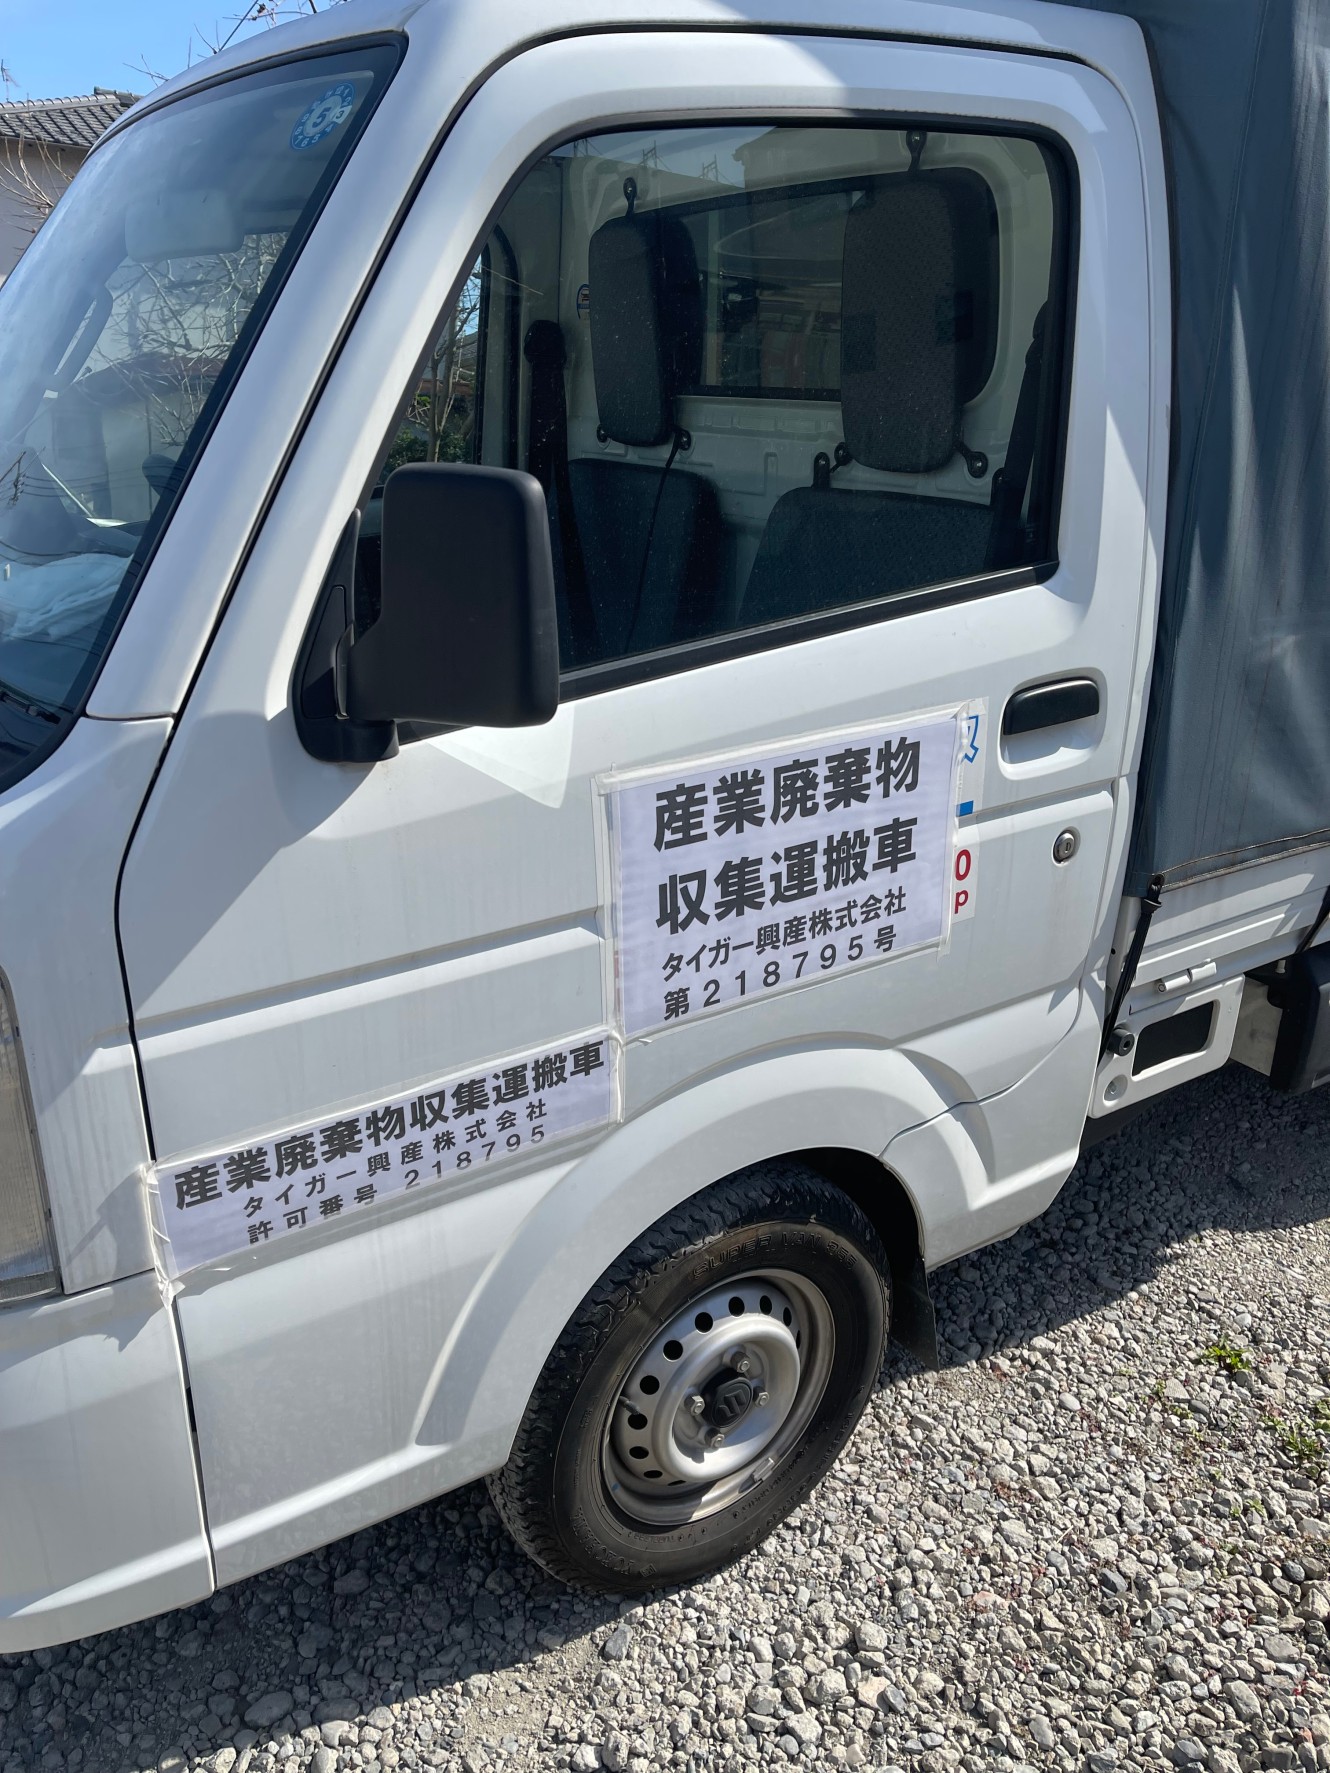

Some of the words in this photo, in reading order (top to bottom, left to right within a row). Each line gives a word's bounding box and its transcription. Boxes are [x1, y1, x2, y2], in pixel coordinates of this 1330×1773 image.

[312, 107, 332, 128] 5
[335, 110, 345, 119] 3
[653, 736, 921, 853] 産業廃棄物
[655, 817, 918, 935] 収集運搬車
[661, 885, 907, 982] タイガー興産株式会社
[174, 1040, 605, 1211] 産業廃棄物収集運搬車
[243, 1099, 547, 1219] タイガー興産株式会社
[247, 1181, 378, 1246] 許可番号
[404, 1124, 547, 1190] 218795
[693, 1234, 773, 1278] SUPER
[781, 1230, 822, 1254] VAN
